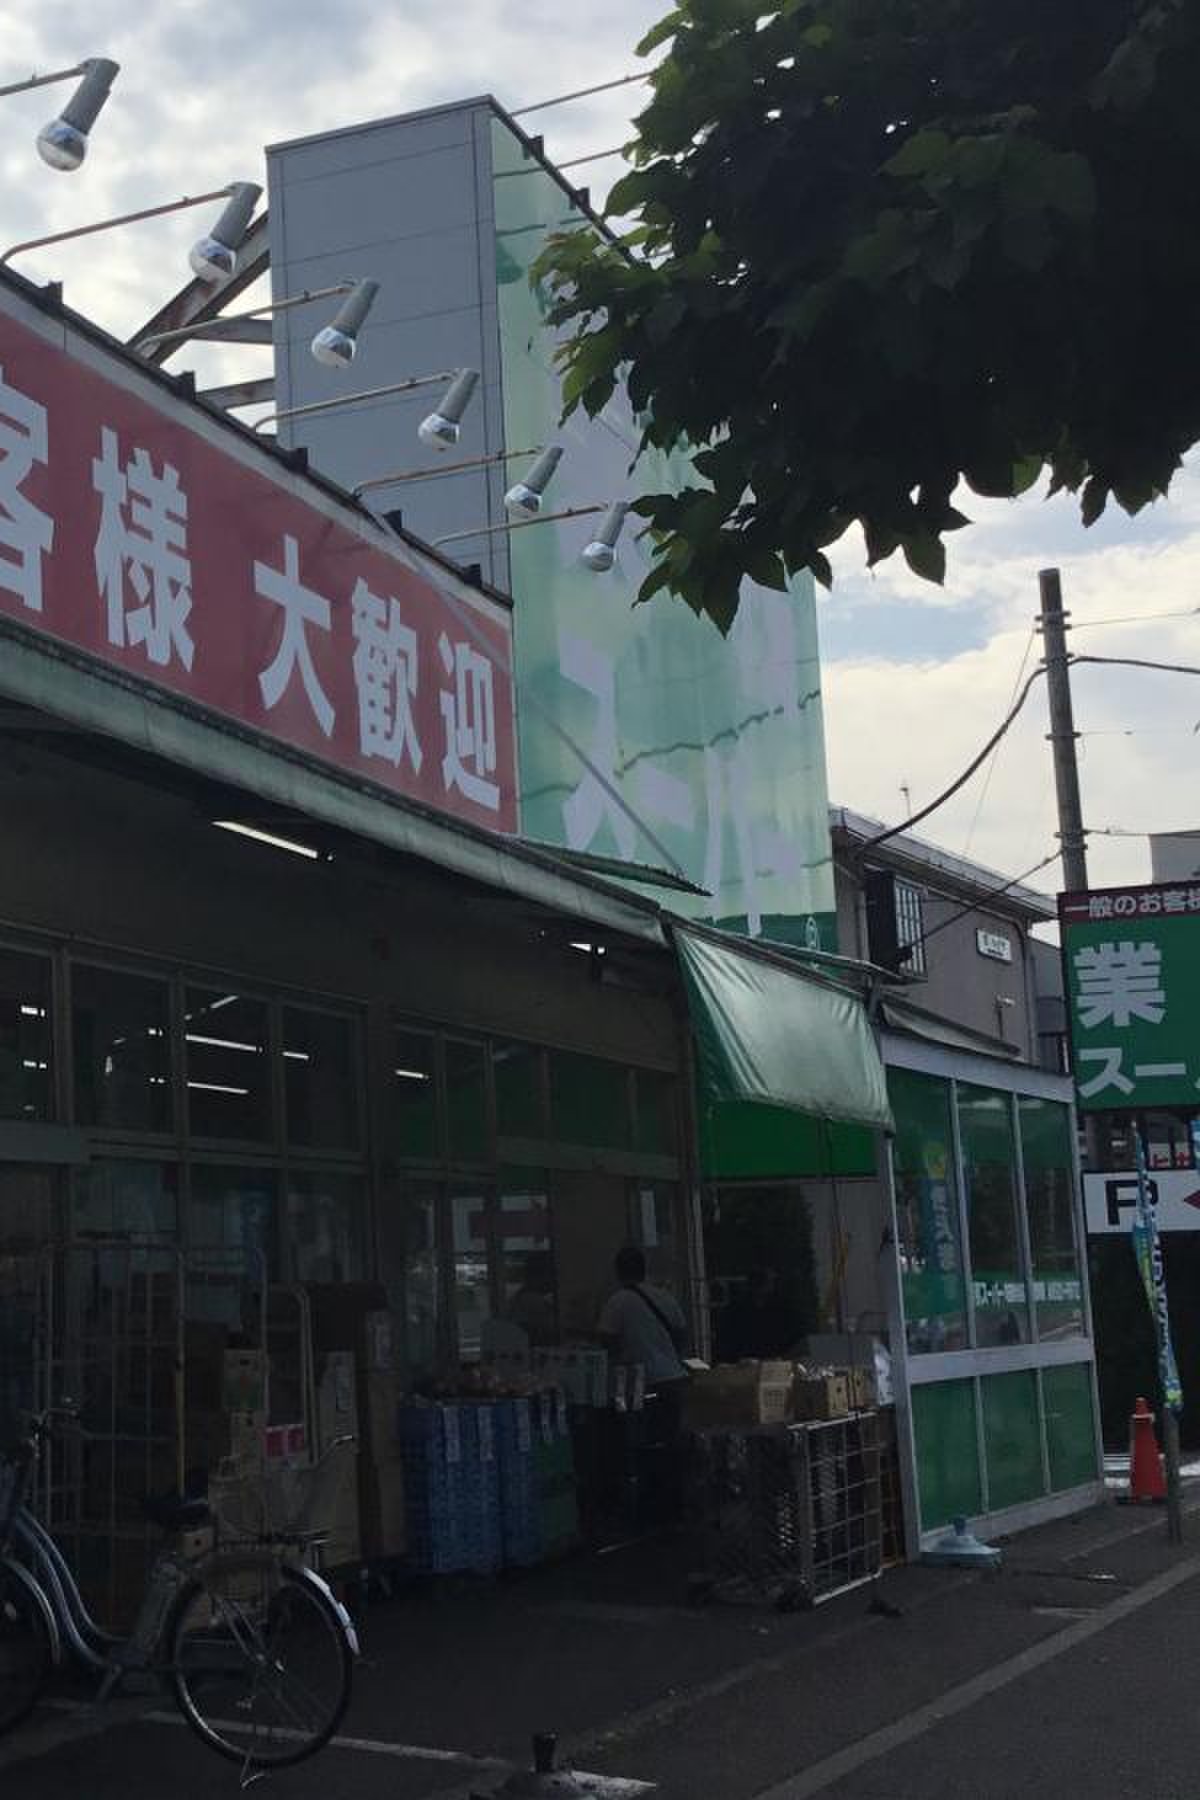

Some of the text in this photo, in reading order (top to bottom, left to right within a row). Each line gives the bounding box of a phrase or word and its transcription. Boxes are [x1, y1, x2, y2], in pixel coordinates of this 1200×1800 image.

[253, 534, 501, 811] 大歓迎
[1073, 941, 1166, 1029] 業
[1077, 1047, 1200, 1099] スー
[1106, 1180, 1158, 1225] P
